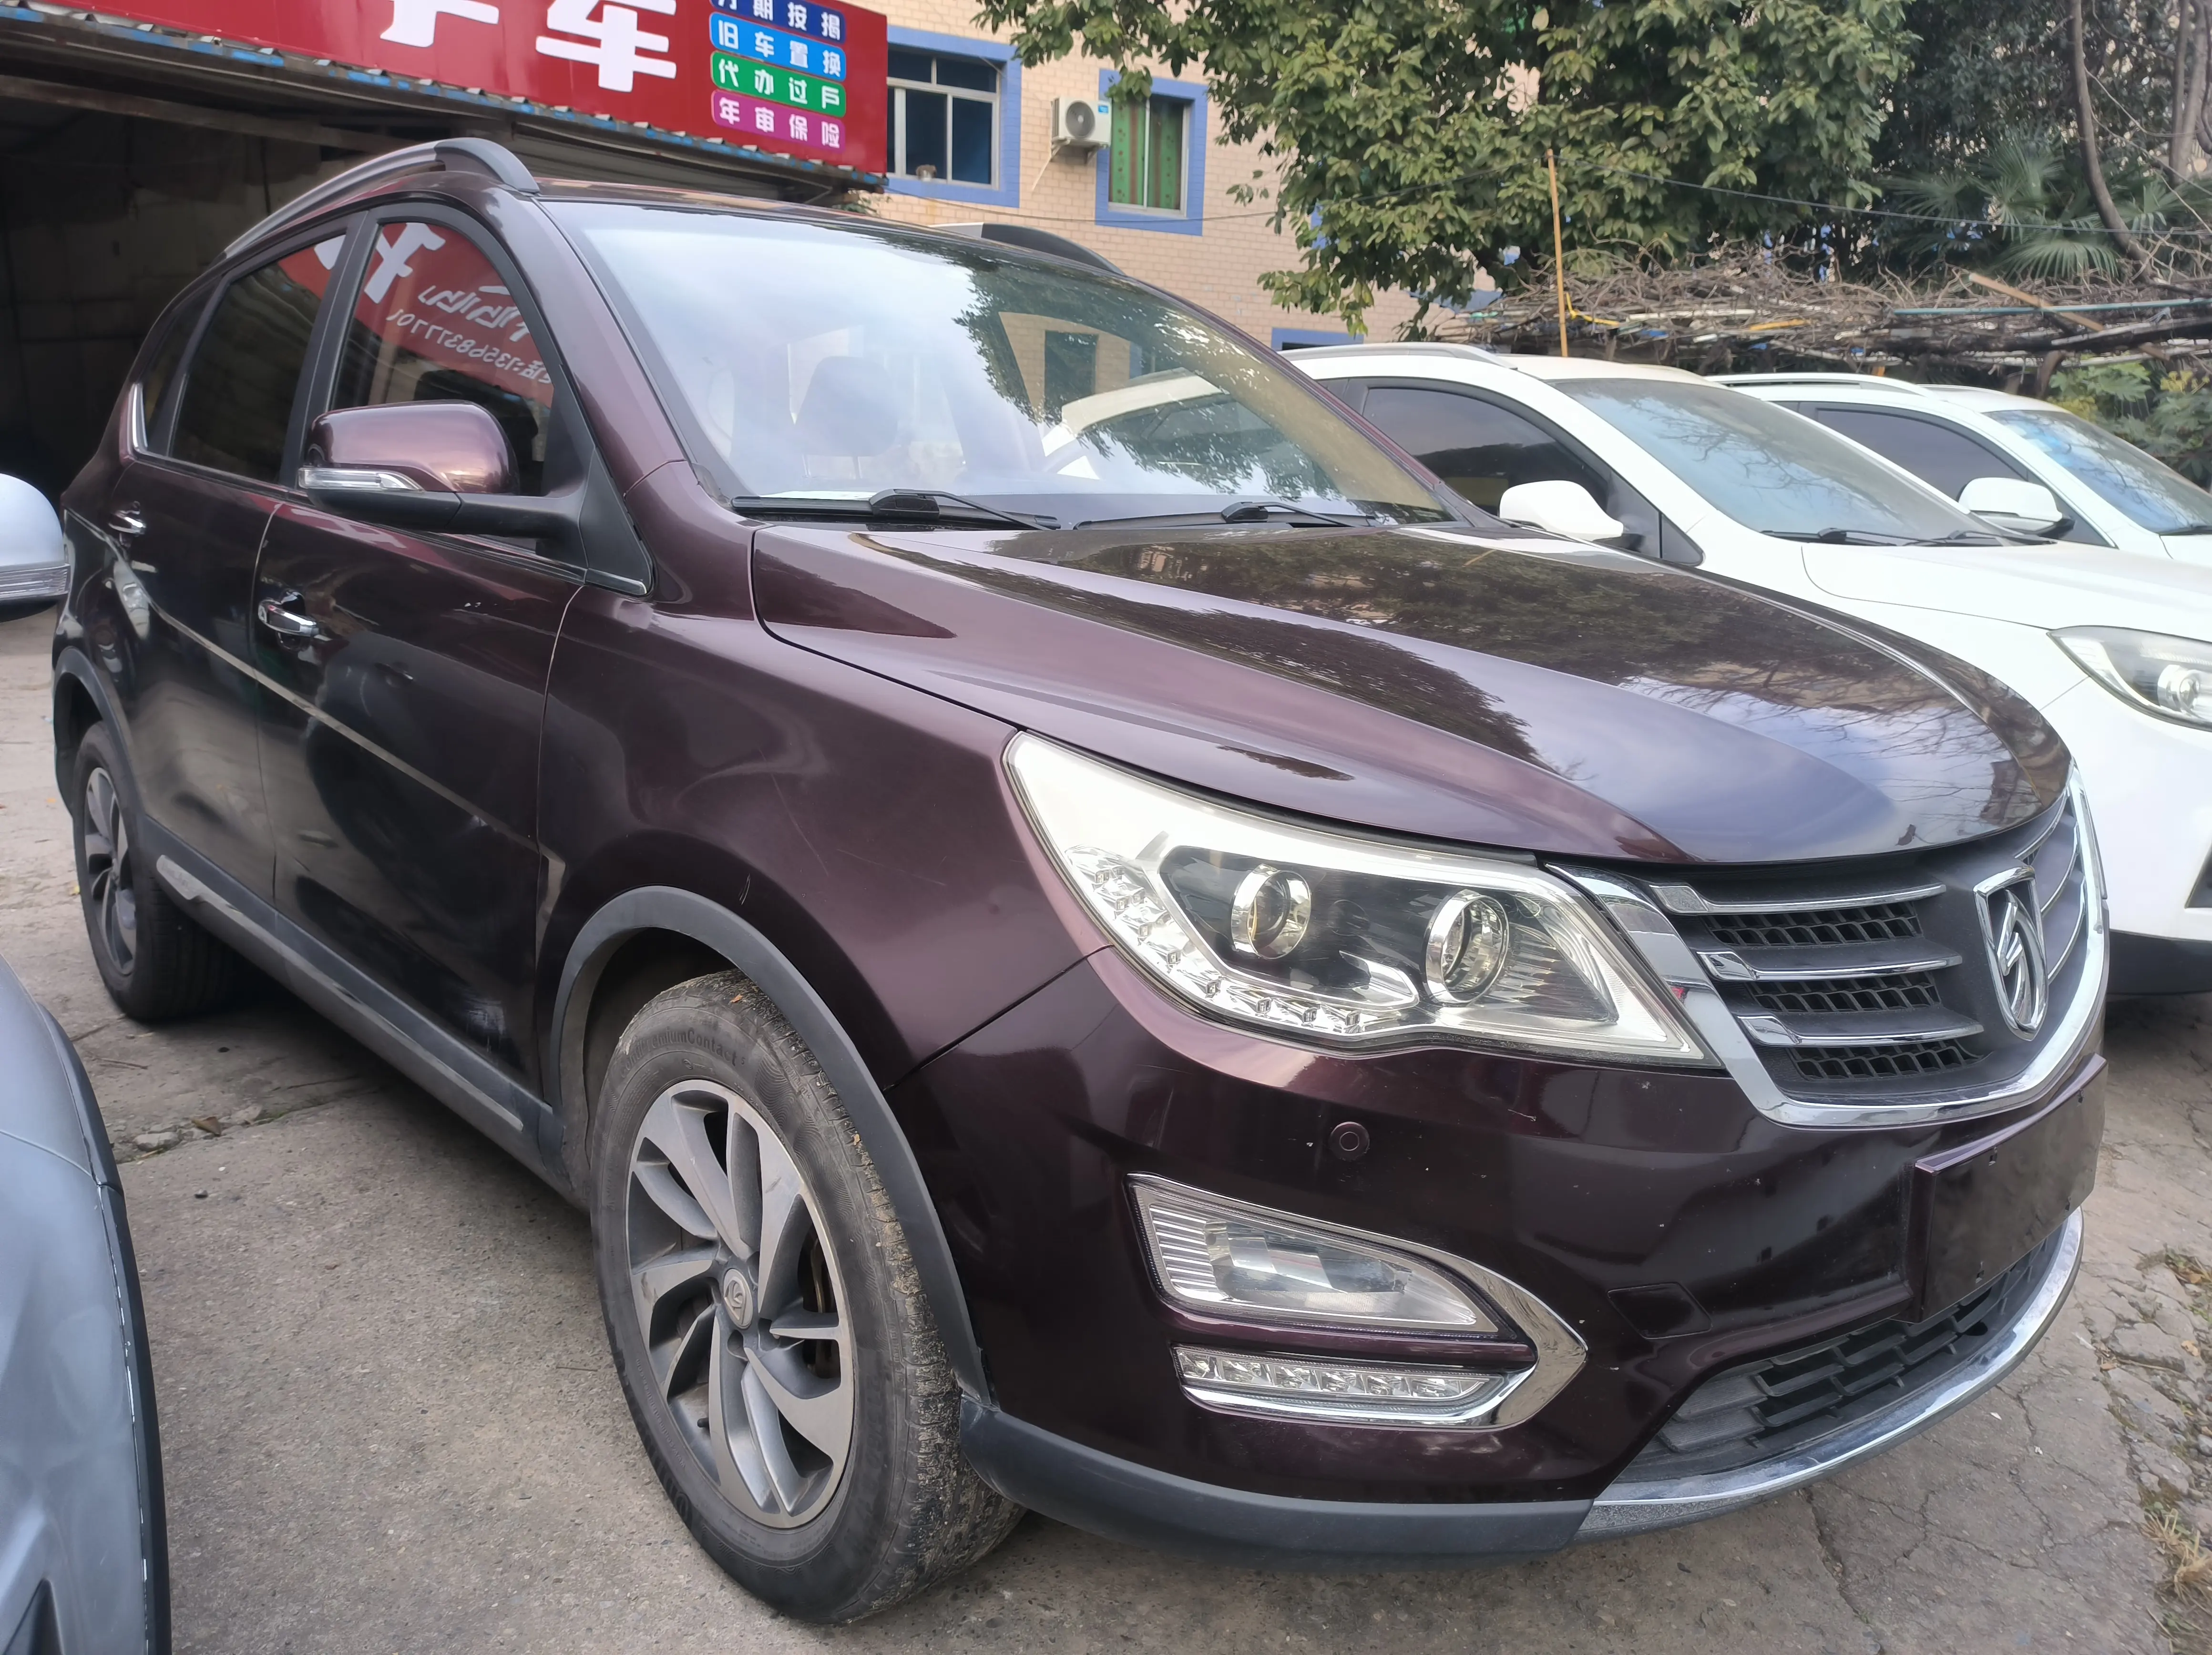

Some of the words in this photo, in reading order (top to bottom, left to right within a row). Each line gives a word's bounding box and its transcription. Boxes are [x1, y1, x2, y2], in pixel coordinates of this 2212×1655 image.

[718, 19, 841, 77] 旧车置换
[718, 58, 840, 109] 代办过户
[719, 97, 840, 148] 年审保险
[740, 1056, 746, 1066] 5
